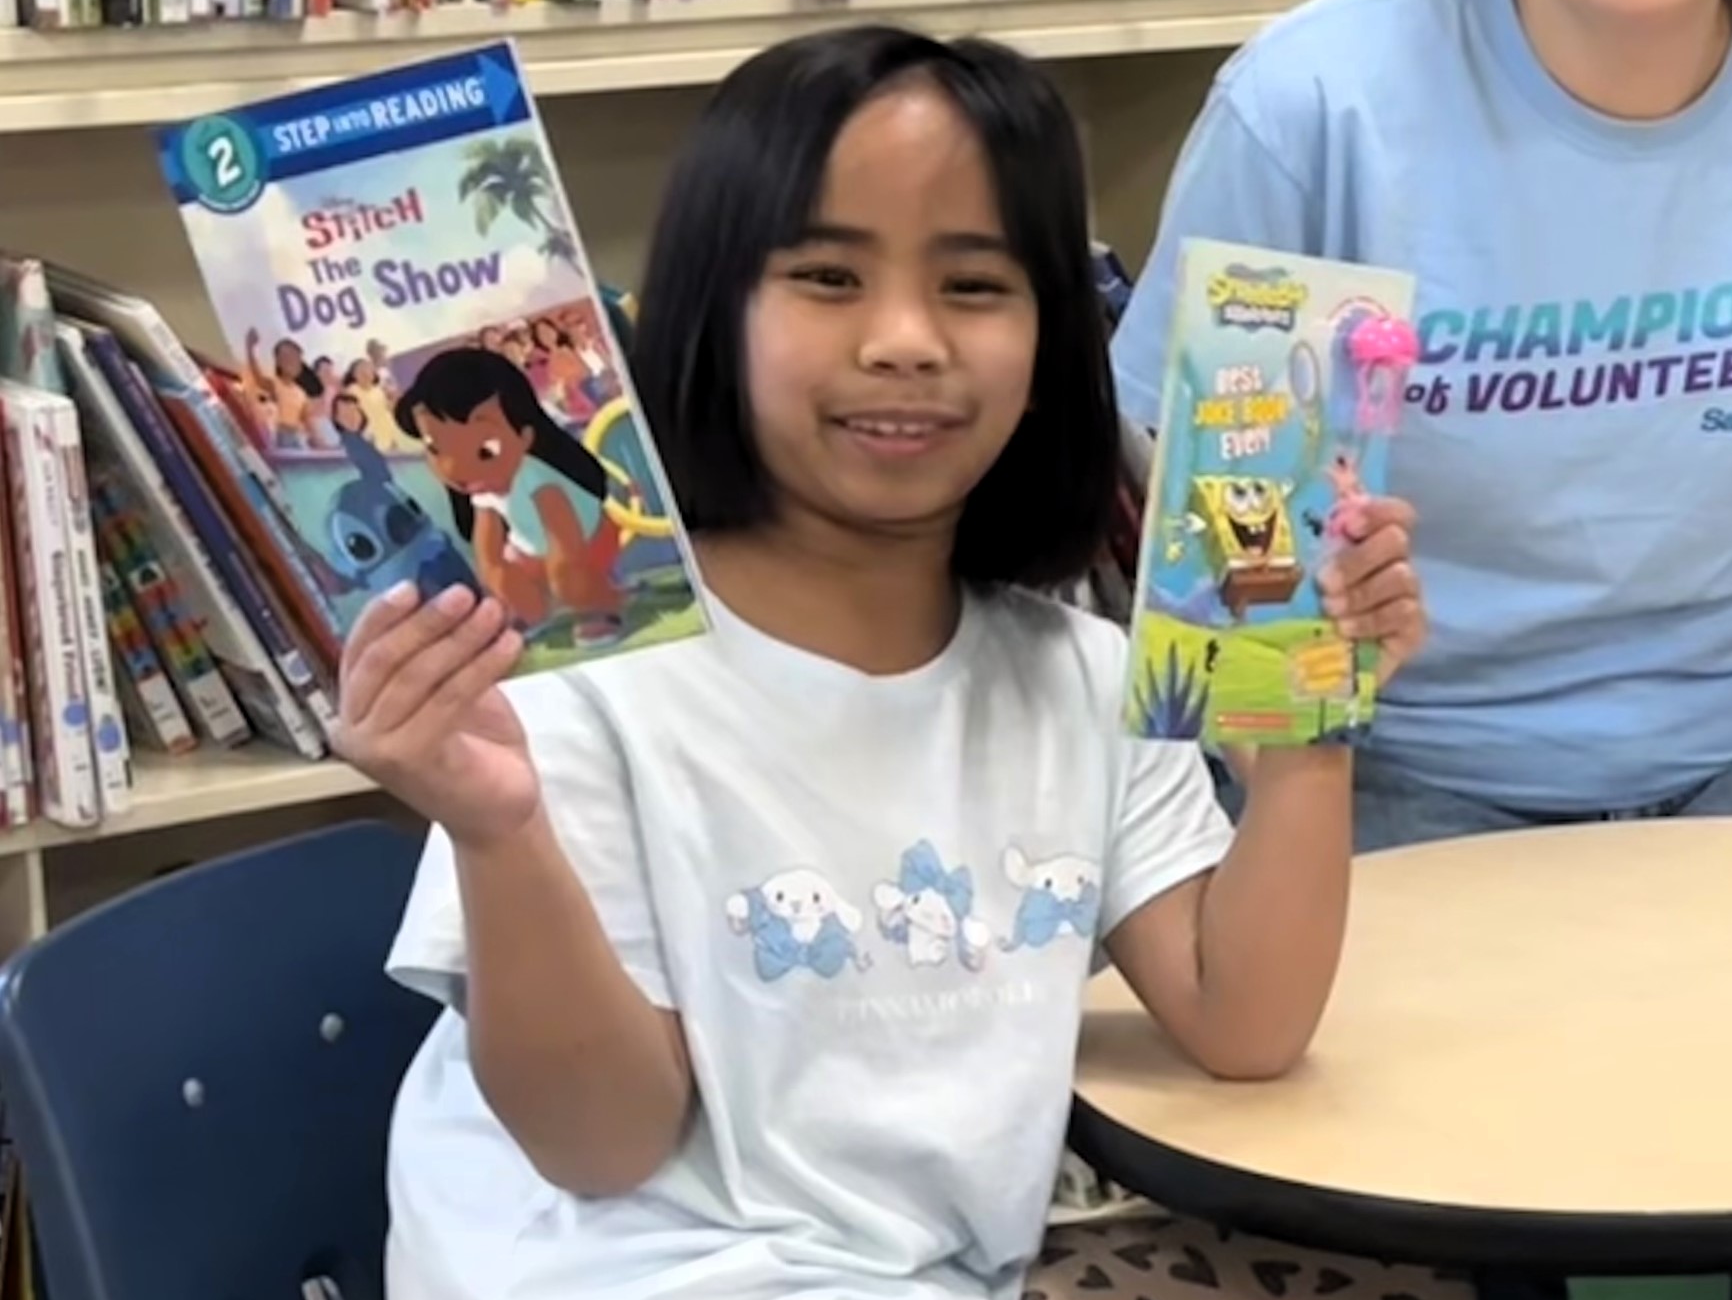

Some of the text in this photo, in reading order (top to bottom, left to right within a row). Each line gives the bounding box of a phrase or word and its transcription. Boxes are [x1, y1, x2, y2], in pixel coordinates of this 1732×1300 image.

[274, 78, 485, 153] STEP INTO READING
[207, 136, 243, 188] 2
[276, 250, 503, 333] Dog Show
[310, 255, 363, 286] The
[1405, 377, 1450, 416] of
